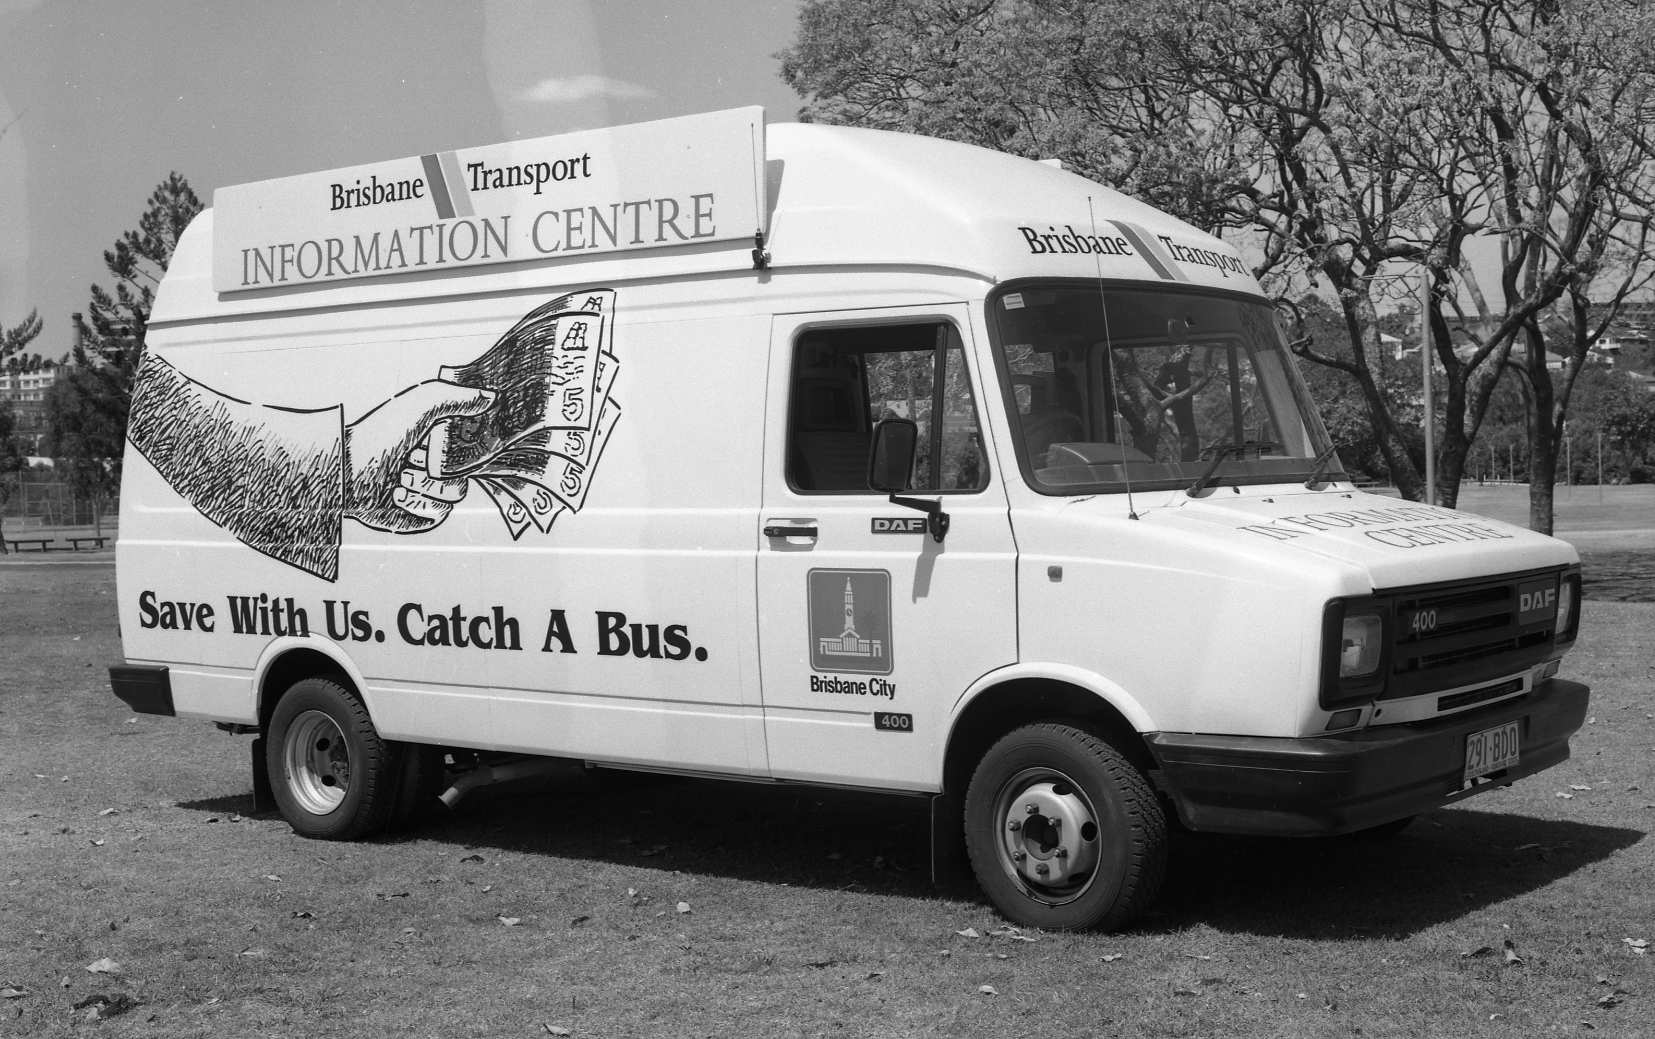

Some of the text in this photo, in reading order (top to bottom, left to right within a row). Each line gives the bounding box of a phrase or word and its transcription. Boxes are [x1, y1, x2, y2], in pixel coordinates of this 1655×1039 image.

[331, 153, 592, 211] Brisbane Transport
[240, 193, 716, 286] INFORMATION CENTRE
[1018, 225, 1250, 278] Brisbane Transport
[874, 519, 923, 531] DAF
[1237, 507, 1514, 548] INFORMATI CENTRE
[1519, 588, 1556, 613] DAF
[139, 590, 709, 662] Save With Us. Catch A Bus.
[1412, 610, 1437, 631] 400
[810, 675, 896, 700] Brisbane City
[881, 715, 909, 729] 400
